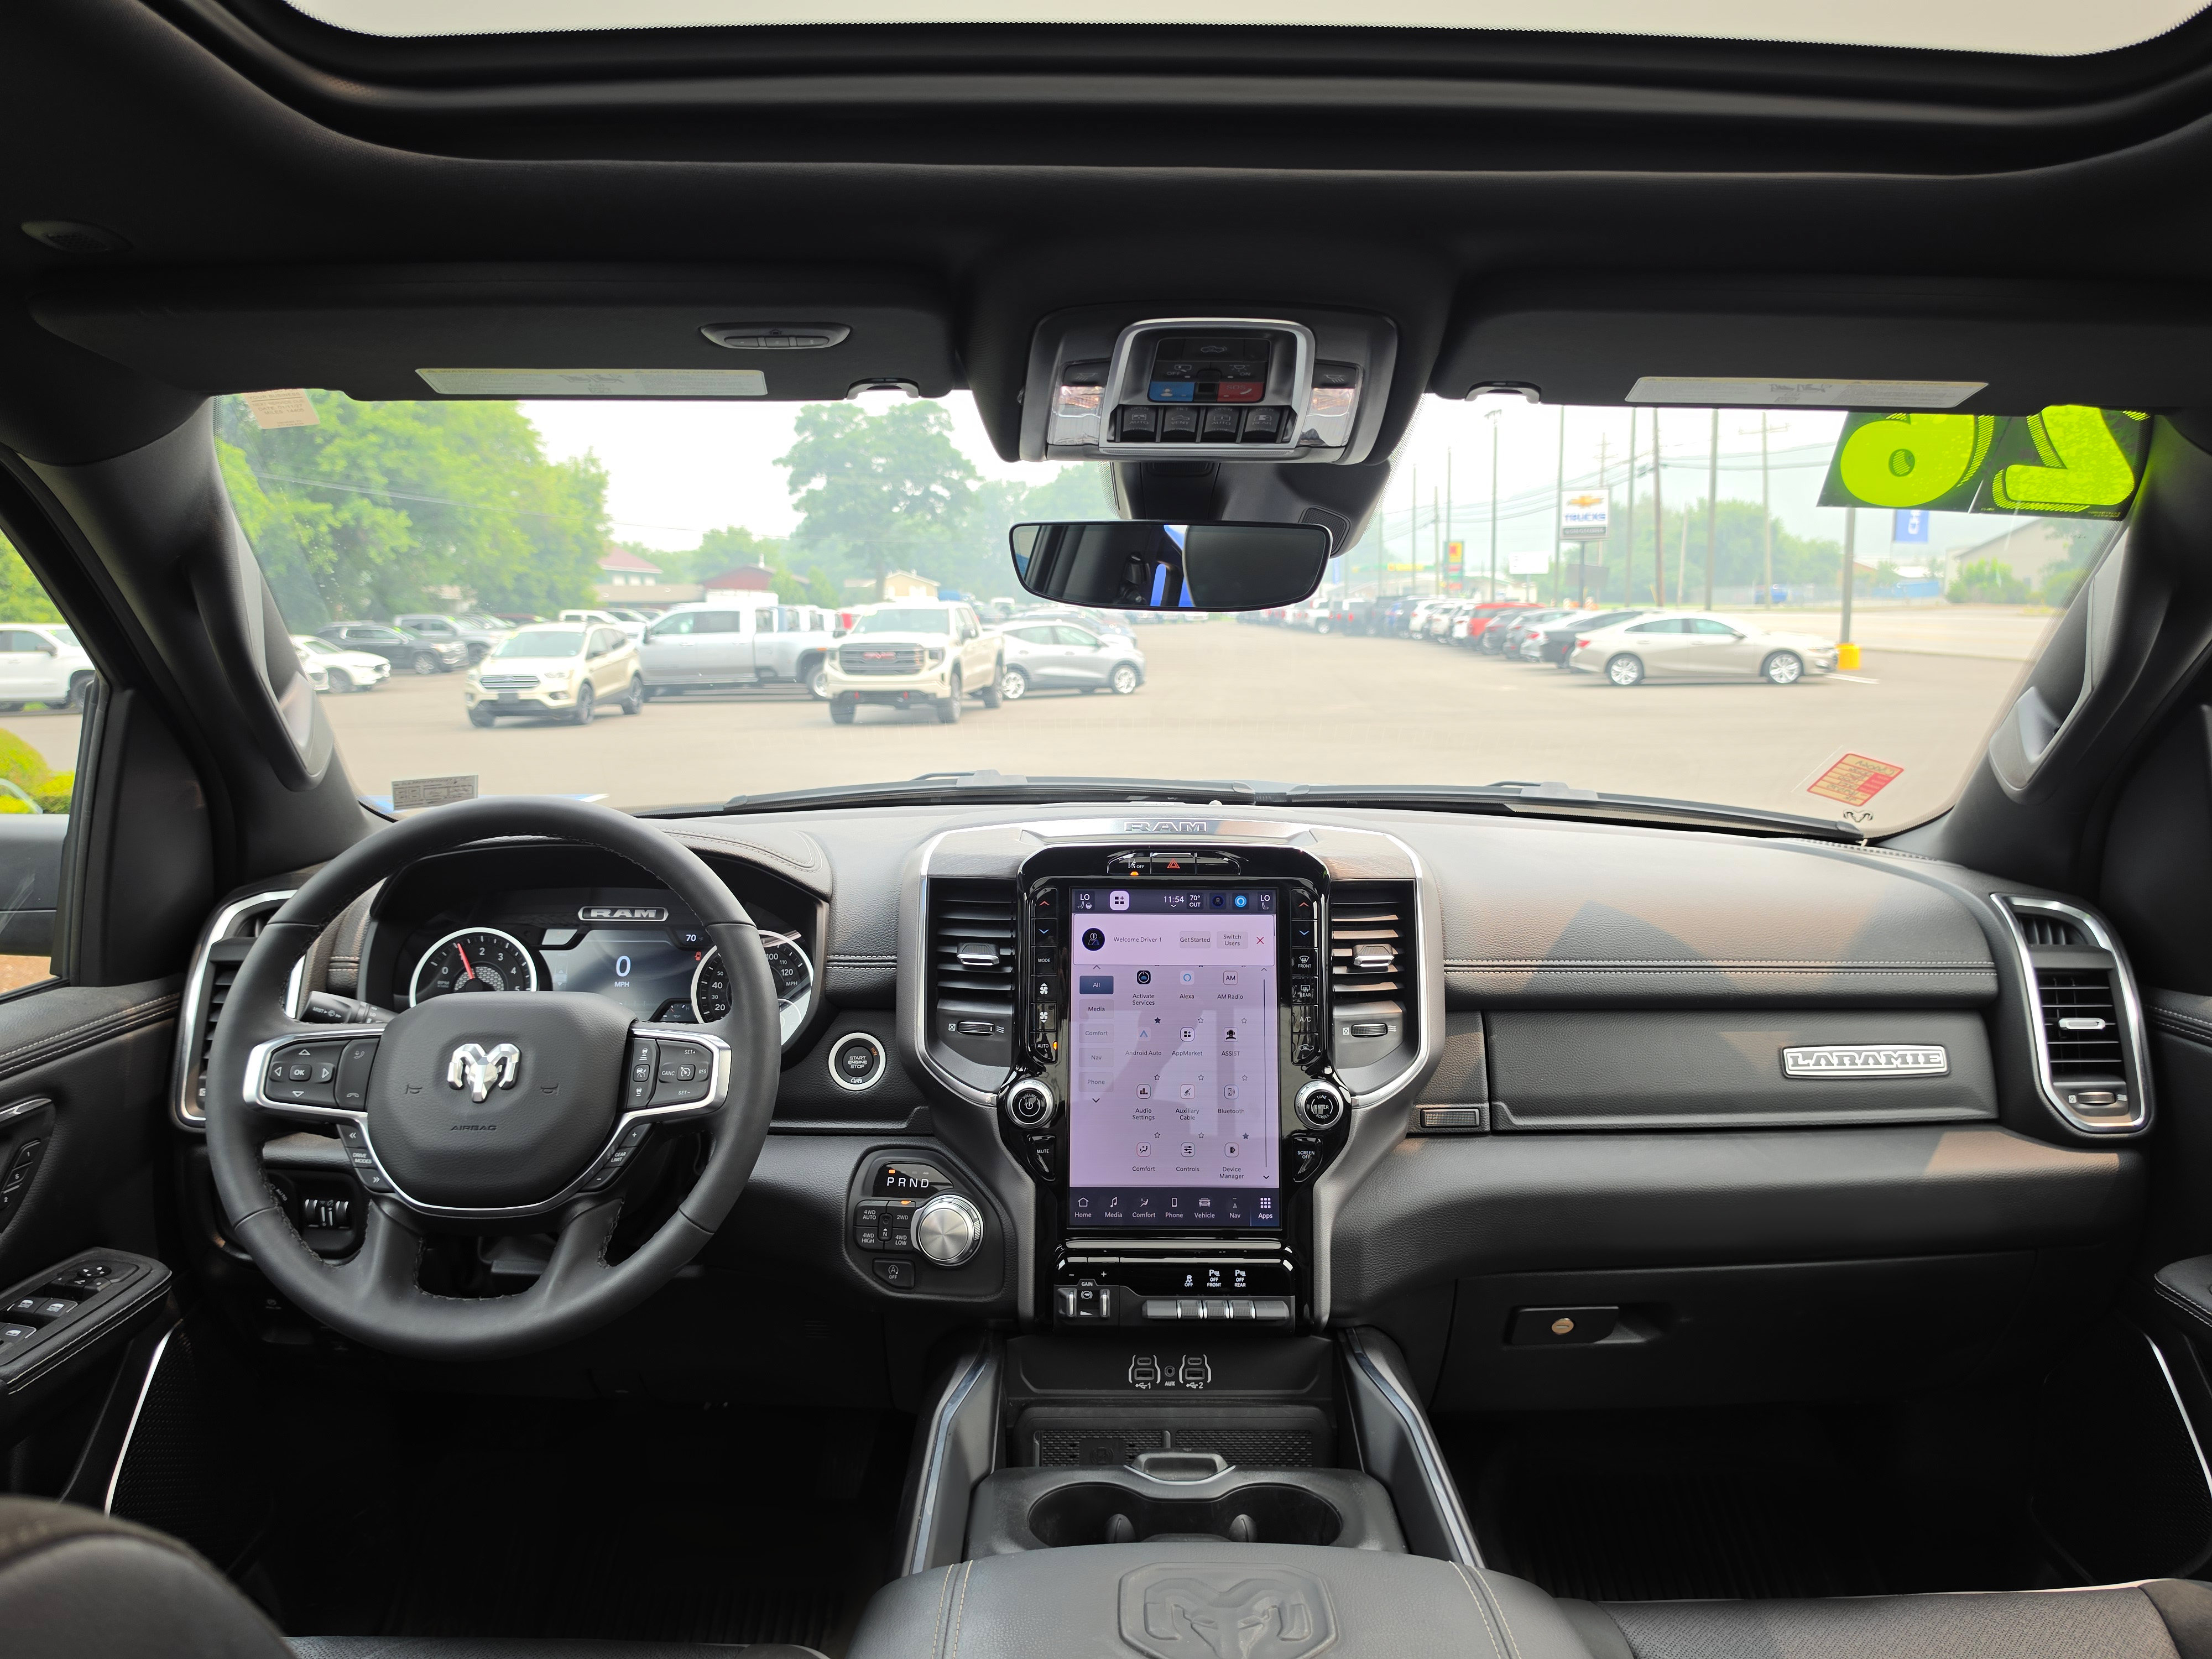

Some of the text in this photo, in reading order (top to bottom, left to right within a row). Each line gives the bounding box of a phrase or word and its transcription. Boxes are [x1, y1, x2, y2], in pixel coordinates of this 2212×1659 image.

[1124, 821, 1207, 832] RAM
[590, 909, 656, 918] RAM
[685, 934, 696, 942] 70
[479, 947, 486, 956] 2
[498, 953, 504, 961] 3
[615, 955, 632, 977] 0
[1789, 1052, 1942, 1067] LARAMIE
[886, 1177, 929, 1188] P R N D
[275, 1188, 288, 1202] AUTO
